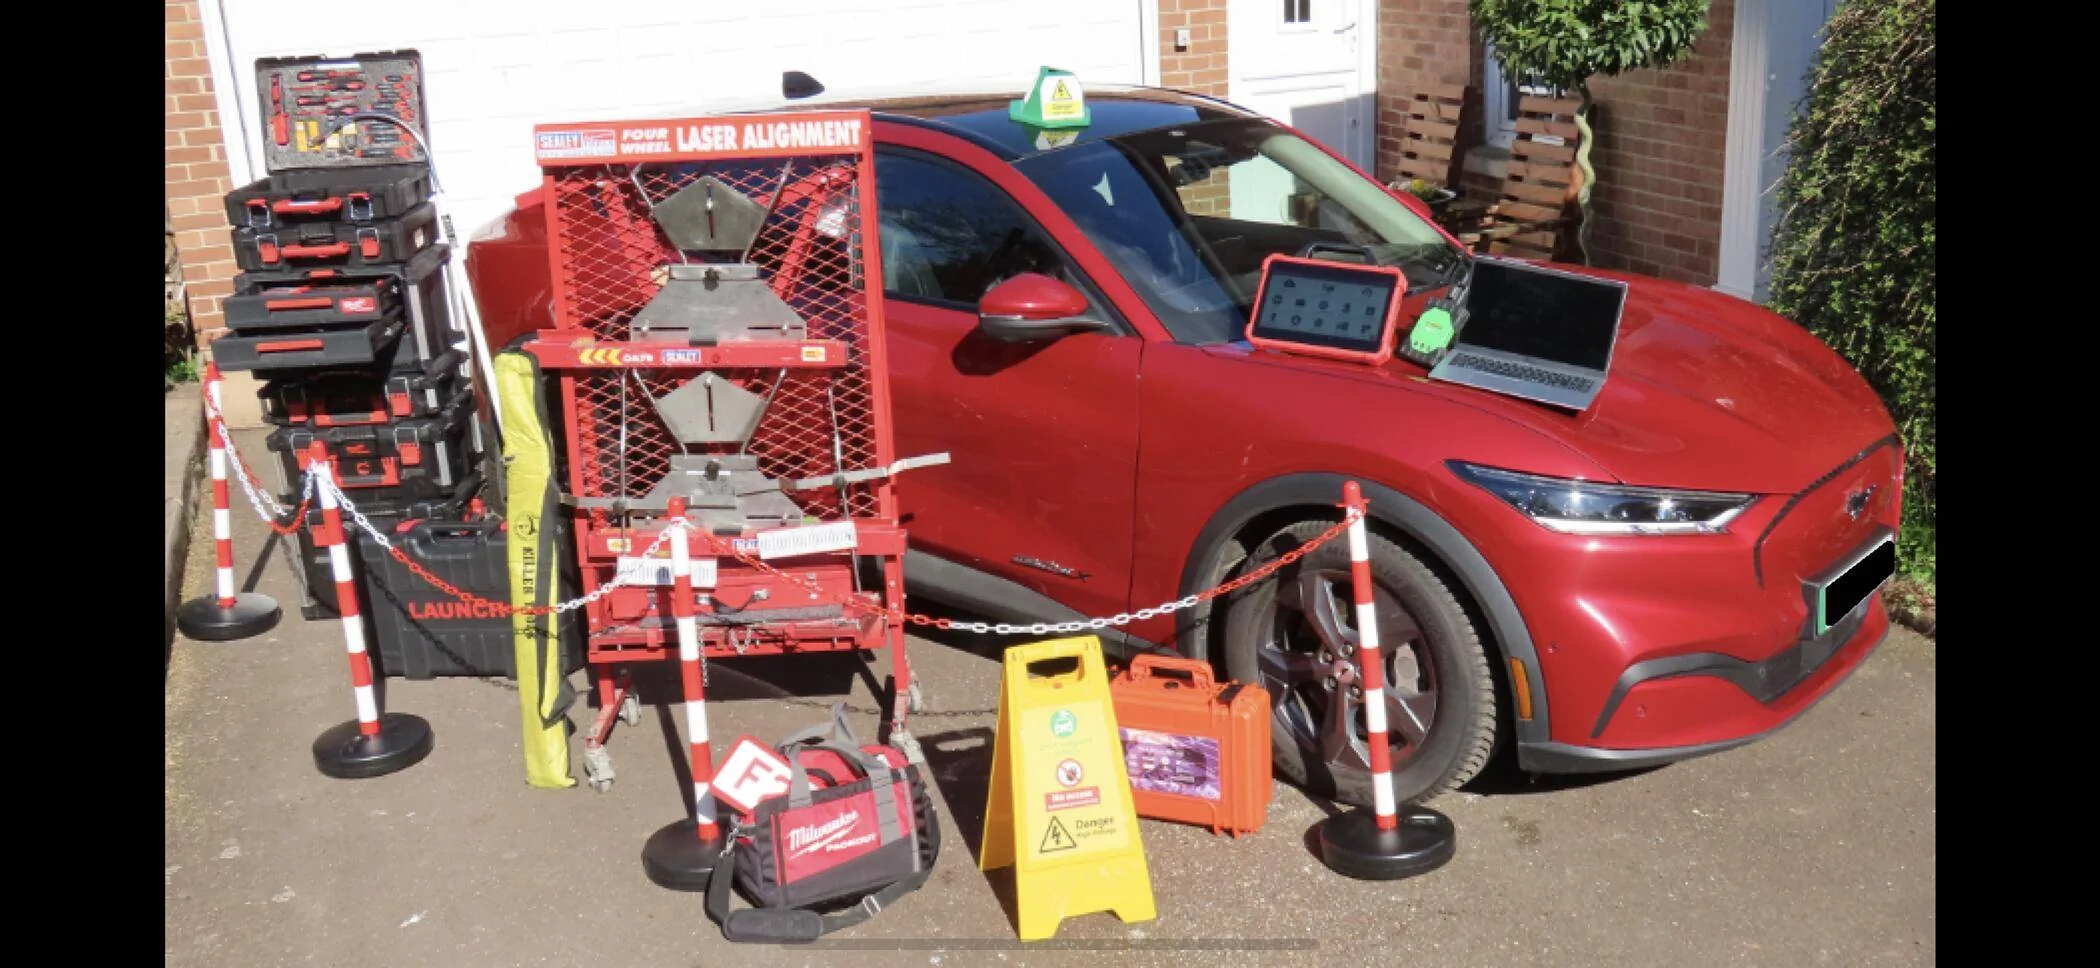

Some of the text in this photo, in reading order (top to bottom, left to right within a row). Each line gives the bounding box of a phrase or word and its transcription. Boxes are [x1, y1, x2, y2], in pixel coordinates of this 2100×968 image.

[622, 128, 668, 141] FOUR
[677, 119, 861, 153] LASER ALIGNMENT
[621, 141, 671, 154] WHEEL
[408, 601, 509, 619] LAUNCH
[786, 811, 859, 850] Milwaukee
[1075, 816, 1115, 830] Danger
